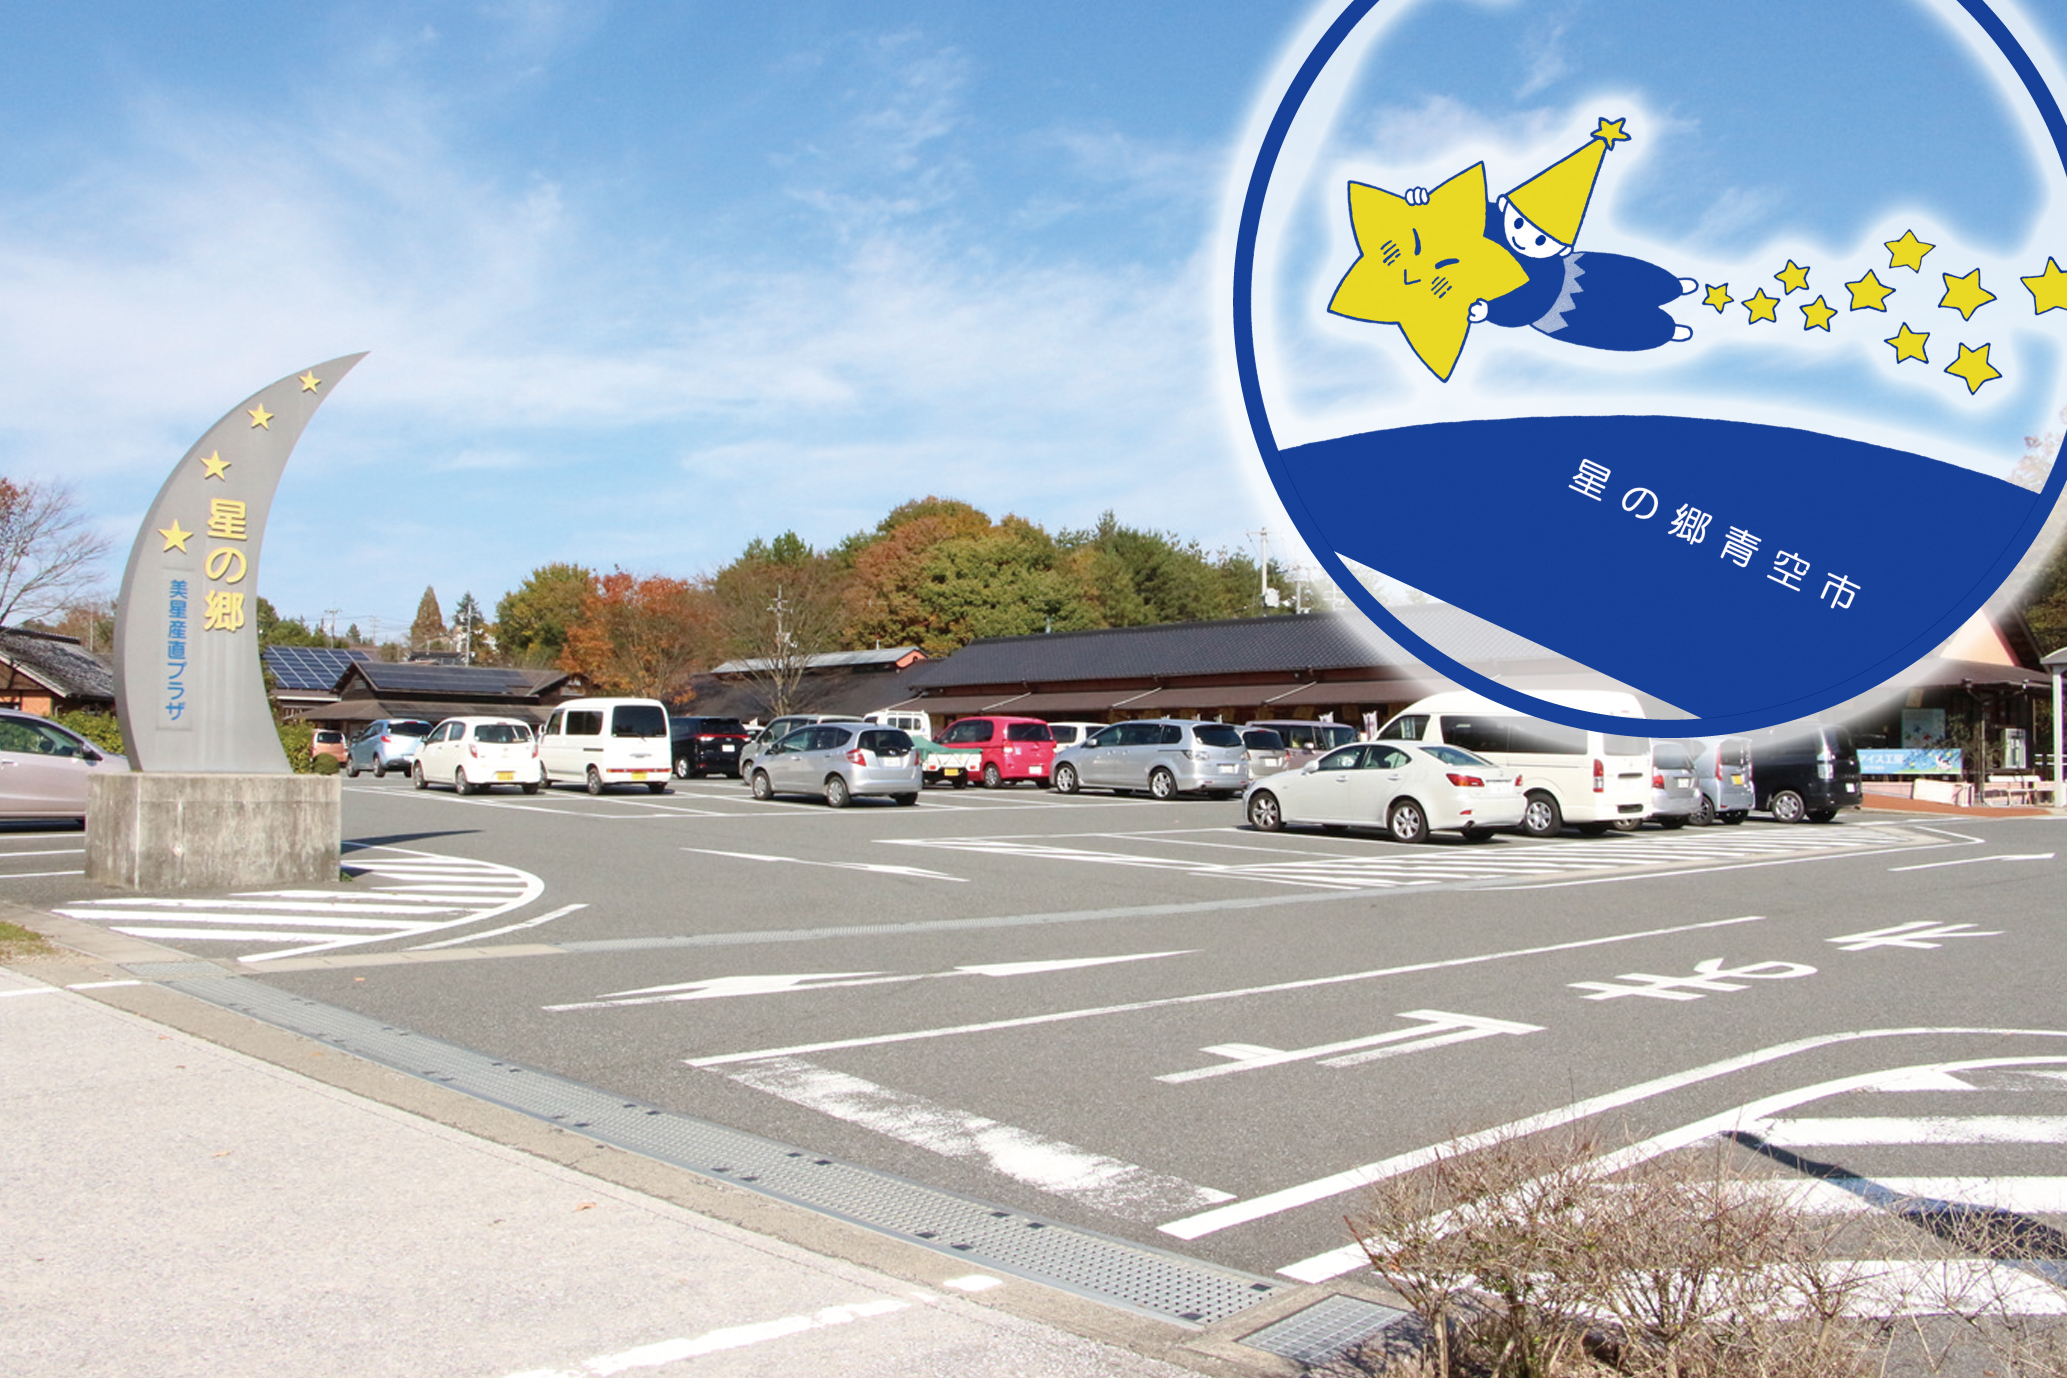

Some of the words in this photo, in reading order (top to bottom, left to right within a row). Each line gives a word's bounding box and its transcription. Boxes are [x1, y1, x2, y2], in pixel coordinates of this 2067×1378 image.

[203, 498, 248, 632] 星の郷
[165, 579, 188, 721] 美星産直プラザ
